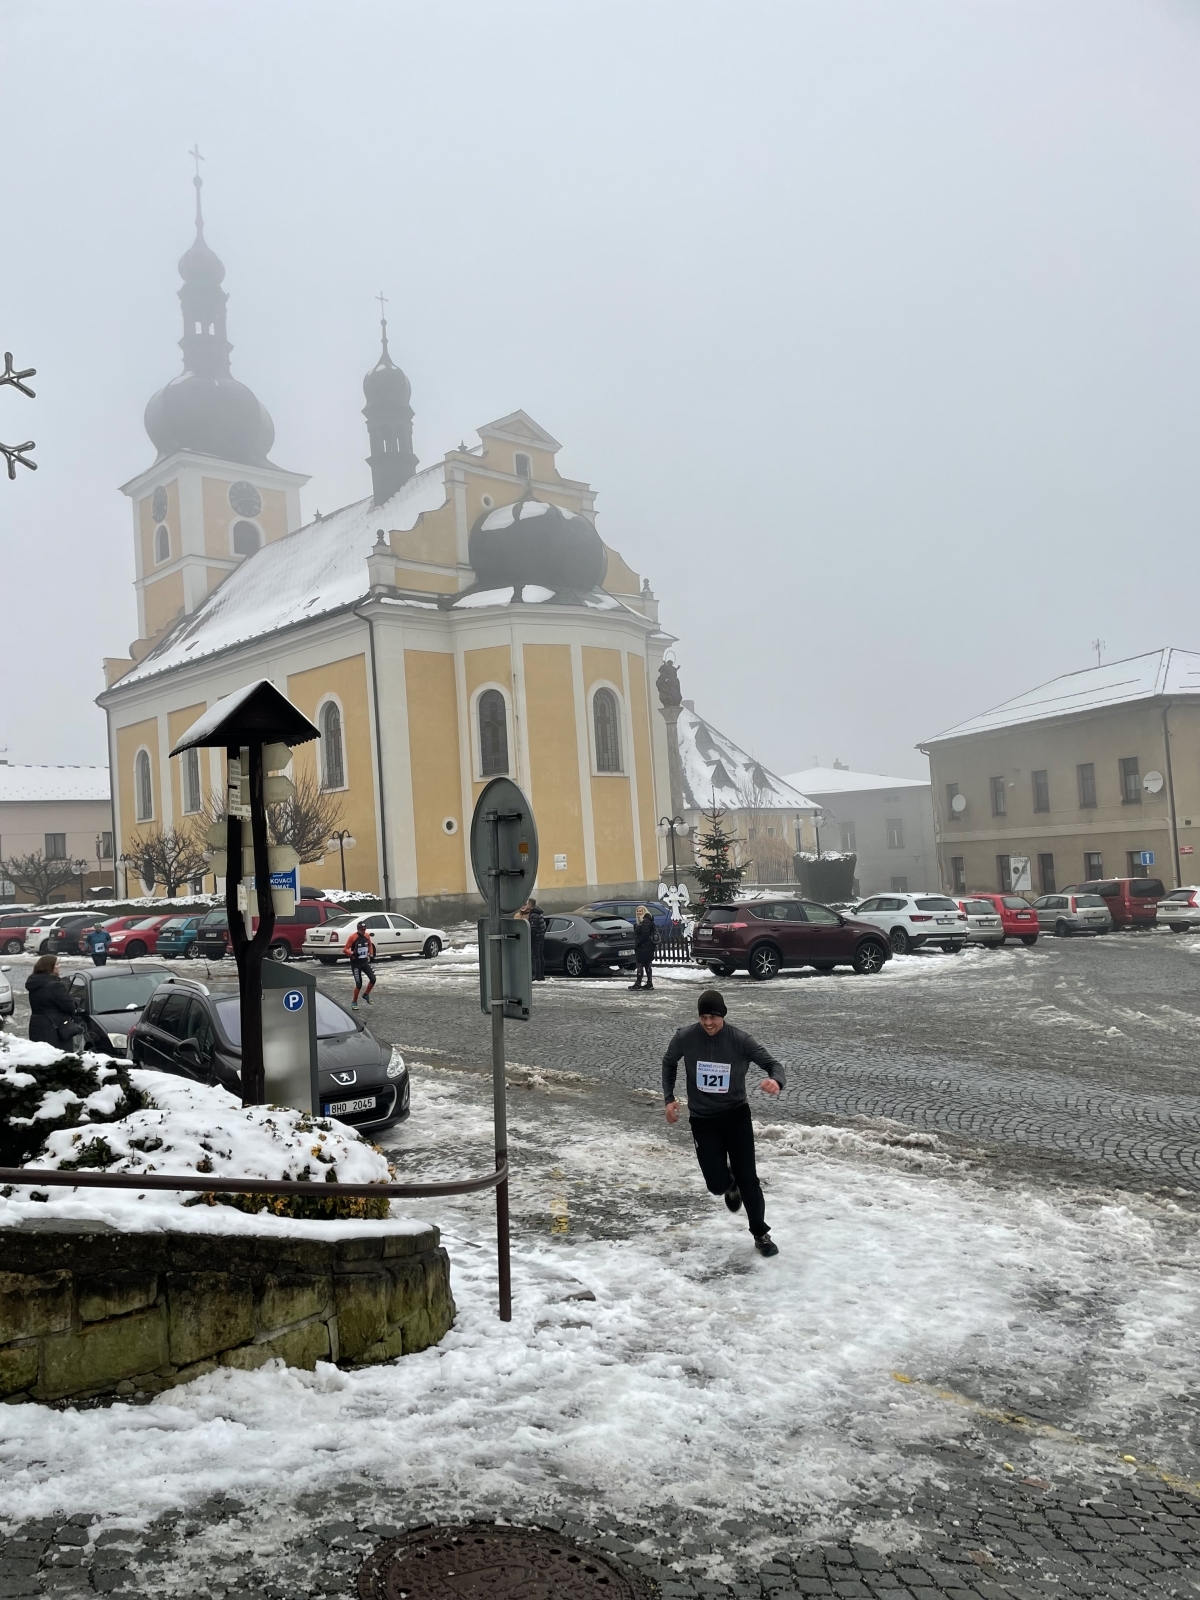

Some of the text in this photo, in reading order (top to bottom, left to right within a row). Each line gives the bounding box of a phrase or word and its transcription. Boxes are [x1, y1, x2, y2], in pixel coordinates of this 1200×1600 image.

[289, 995, 299, 1007] P
[702, 1074, 723, 1087] 121
[353, 1099, 372, 1110] 2045
